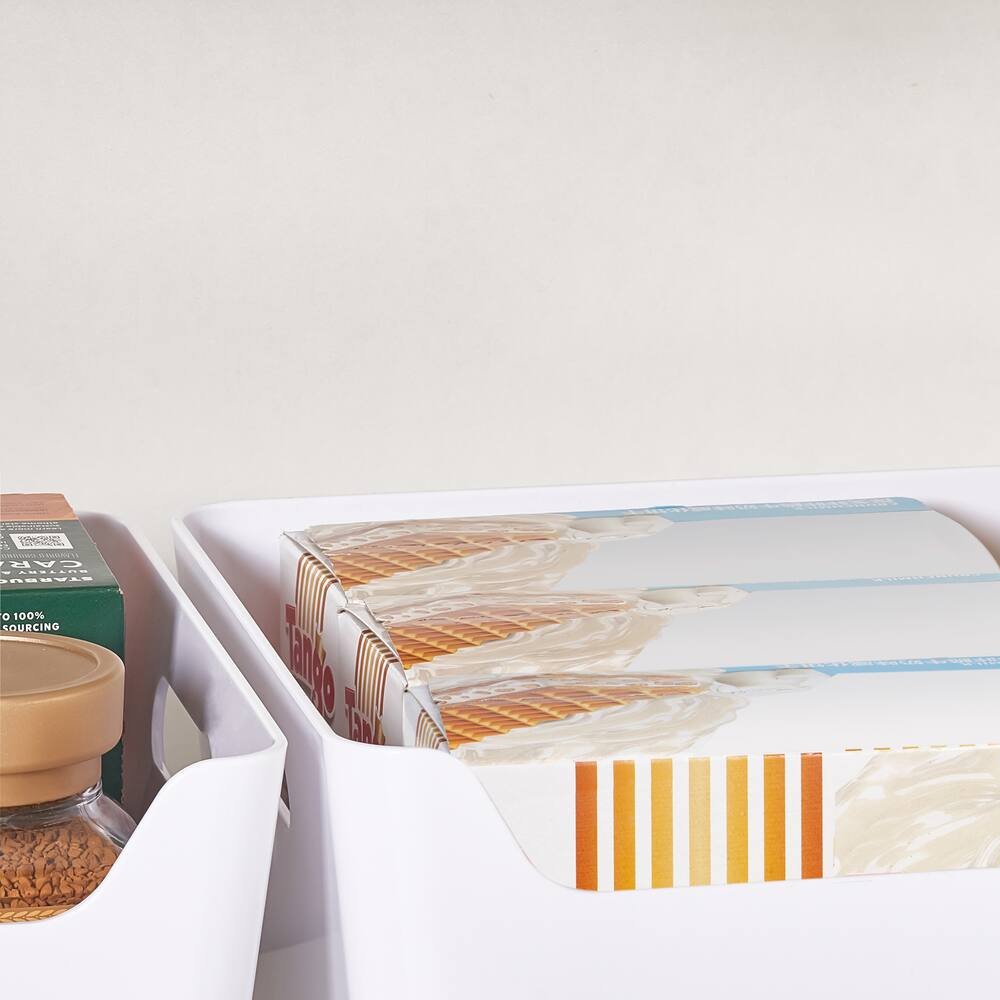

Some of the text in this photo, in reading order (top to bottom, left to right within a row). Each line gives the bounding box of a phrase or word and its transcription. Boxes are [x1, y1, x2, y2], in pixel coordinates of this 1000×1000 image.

[0, 560, 83, 569] CAR
[0, 611, 45, 621] O 100%
[2, 622, 60, 632] SOURCING
